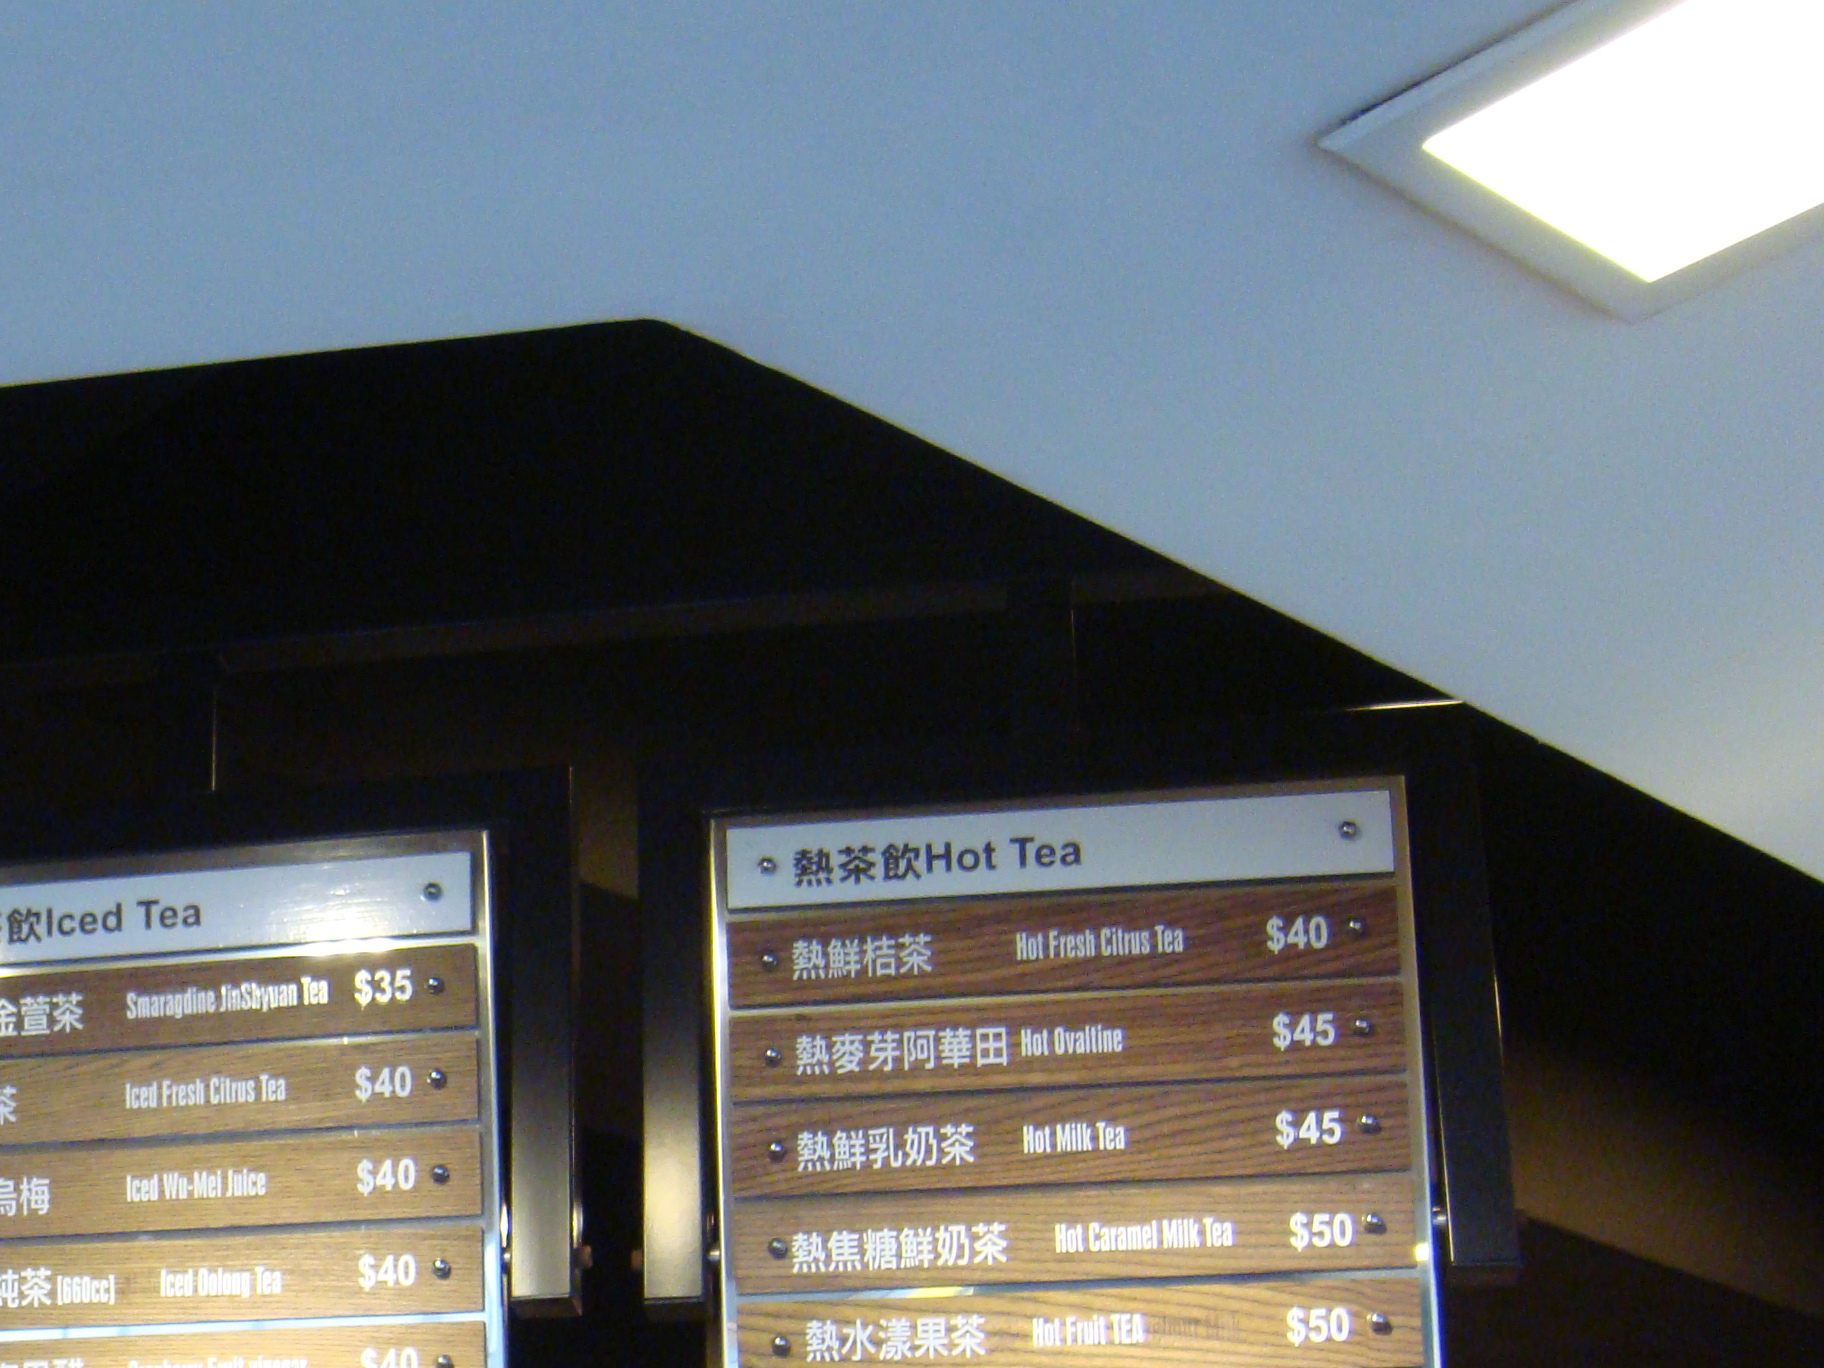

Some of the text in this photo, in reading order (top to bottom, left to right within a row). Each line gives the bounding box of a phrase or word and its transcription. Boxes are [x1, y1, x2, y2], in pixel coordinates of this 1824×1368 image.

[1010, 837, 1080, 868] Tea
[137, 900, 200, 929] Tea
[1017, 916, 1327, 960] Hot Fresh Citrus Tea $40
[302, 976, 328, 1004] Tea
[355, 969, 412, 1006] $35
[1022, 1013, 1335, 1055] Hot Ovaltine $45
[126, 1066, 412, 1108] Iced Fresh Citrus Tea $40
[798, 1111, 1341, 1171] 熱鮮乳奶茶 Hot Milk Tea $45
[127, 1158, 417, 1201] Iced Wu-Mei Juice $40
[793, 1212, 1353, 1272] 熱焦糖鮮奶茶 Hot Caramel Milk Tea $50
[161, 1269, 195, 1296] Iced
[198, 1268, 253, 1298] Oolong
[251, 1266, 284, 1294] Tea
[359, 1254, 416, 1291] $40
[1034, 1318, 1064, 1347] Hot
[1066, 1315, 1110, 1345] Fruit
[1111, 1313, 1148, 1343] TEA
[1288, 1306, 1350, 1345] $50
